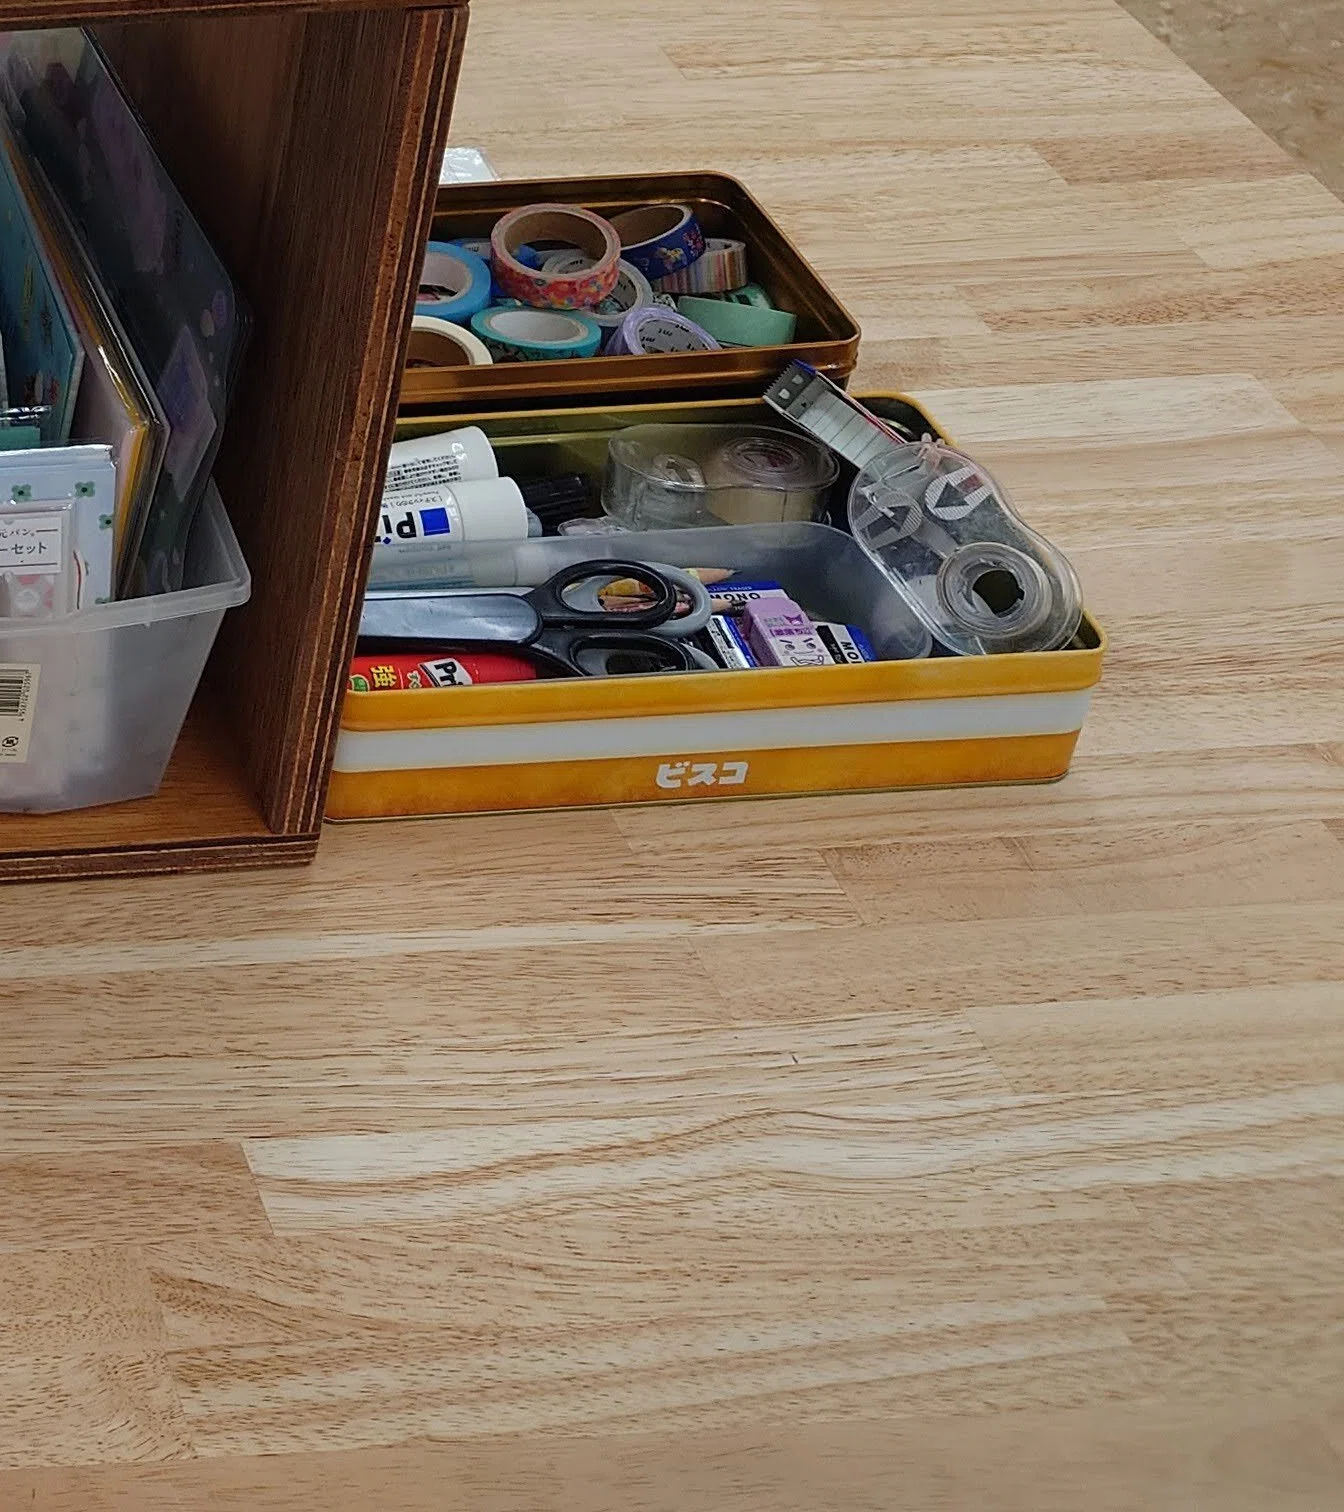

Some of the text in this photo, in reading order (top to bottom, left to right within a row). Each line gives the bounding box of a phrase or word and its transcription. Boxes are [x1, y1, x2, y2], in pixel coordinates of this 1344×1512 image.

[375, 511, 417, 546] Pi
[370, 665, 398, 688] 強
[655, 760, 749, 789] ビスコ
